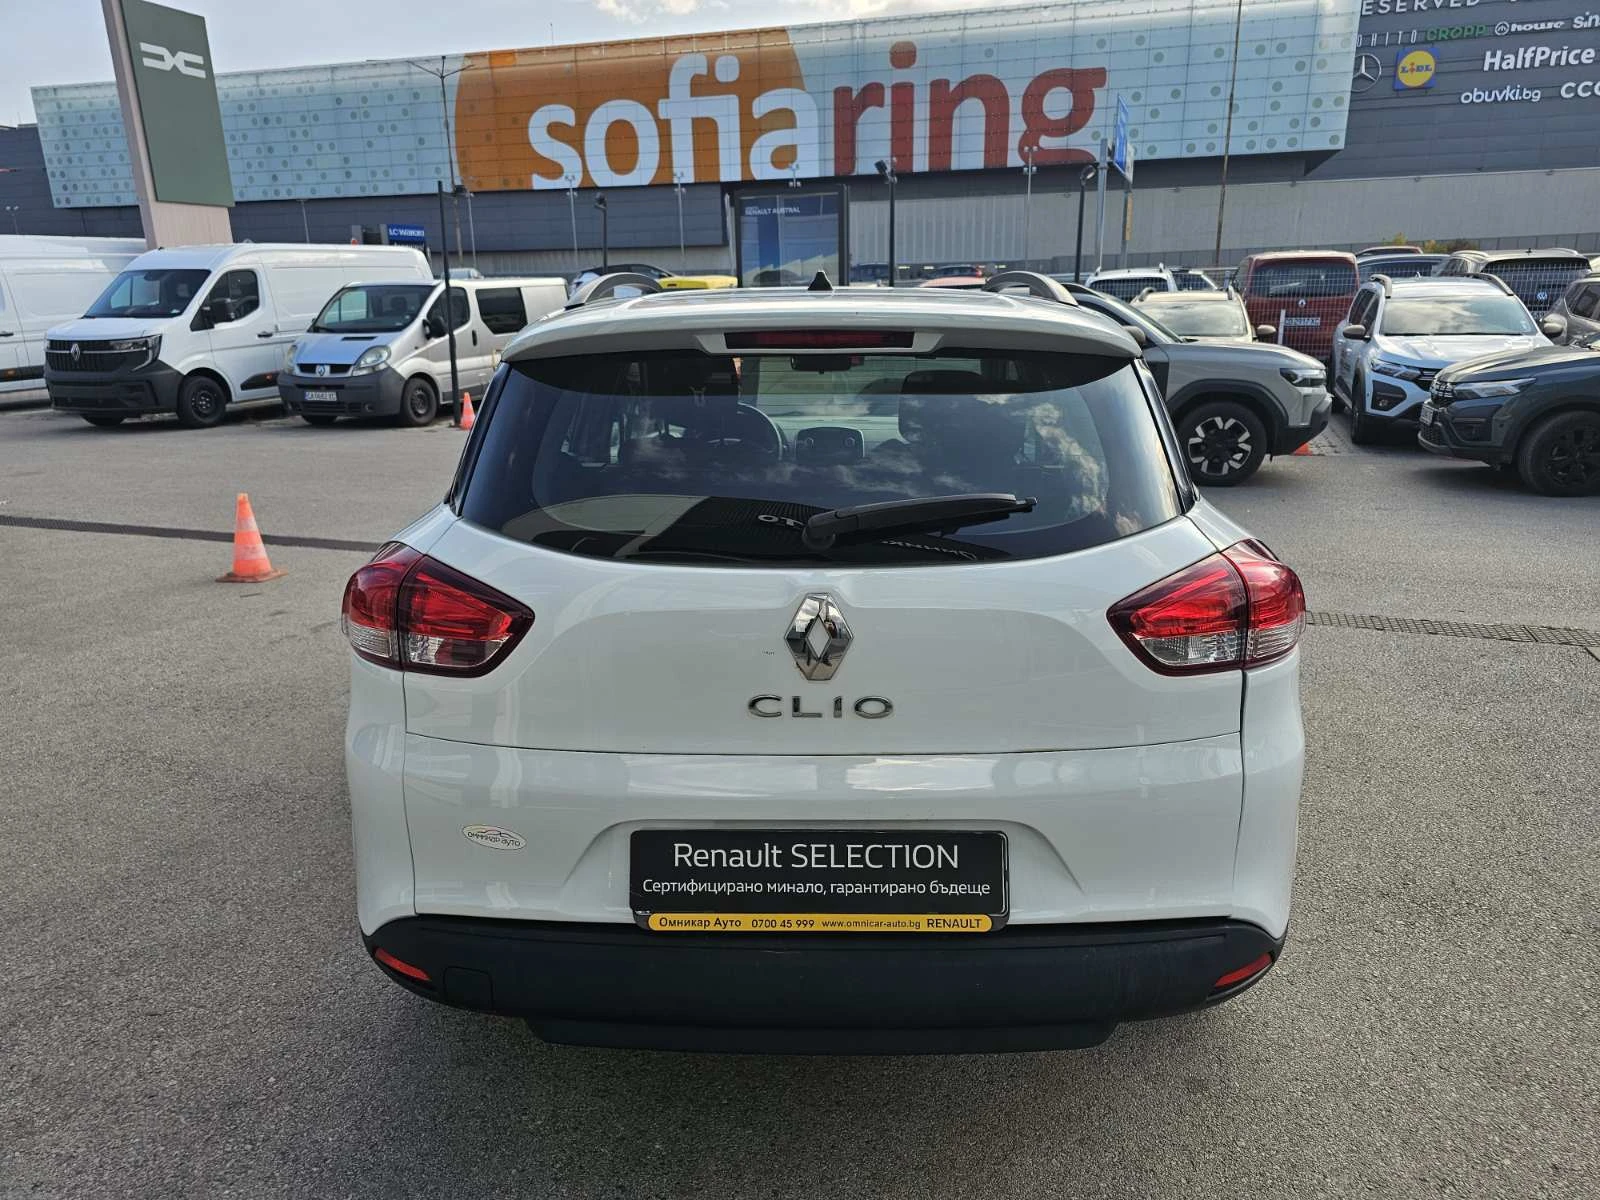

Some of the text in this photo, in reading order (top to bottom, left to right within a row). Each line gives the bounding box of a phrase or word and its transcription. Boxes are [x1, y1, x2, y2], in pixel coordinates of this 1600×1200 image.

[1426, 25, 1487, 41] CROPP
[1482, 46, 1596, 71] HalfPrice
[1460, 85, 1541, 103] obuvki.bg
[748, 694, 893, 719] CLIO
[674, 843, 958, 868] Renault SELECTION
[642, 879, 991, 896] Сертифицирано минало, гарантирано бъдеще
[659, 917, 983, 929] Омникар Ауто 0700 45 999 www.omnicar-auto.bg RENAULT
